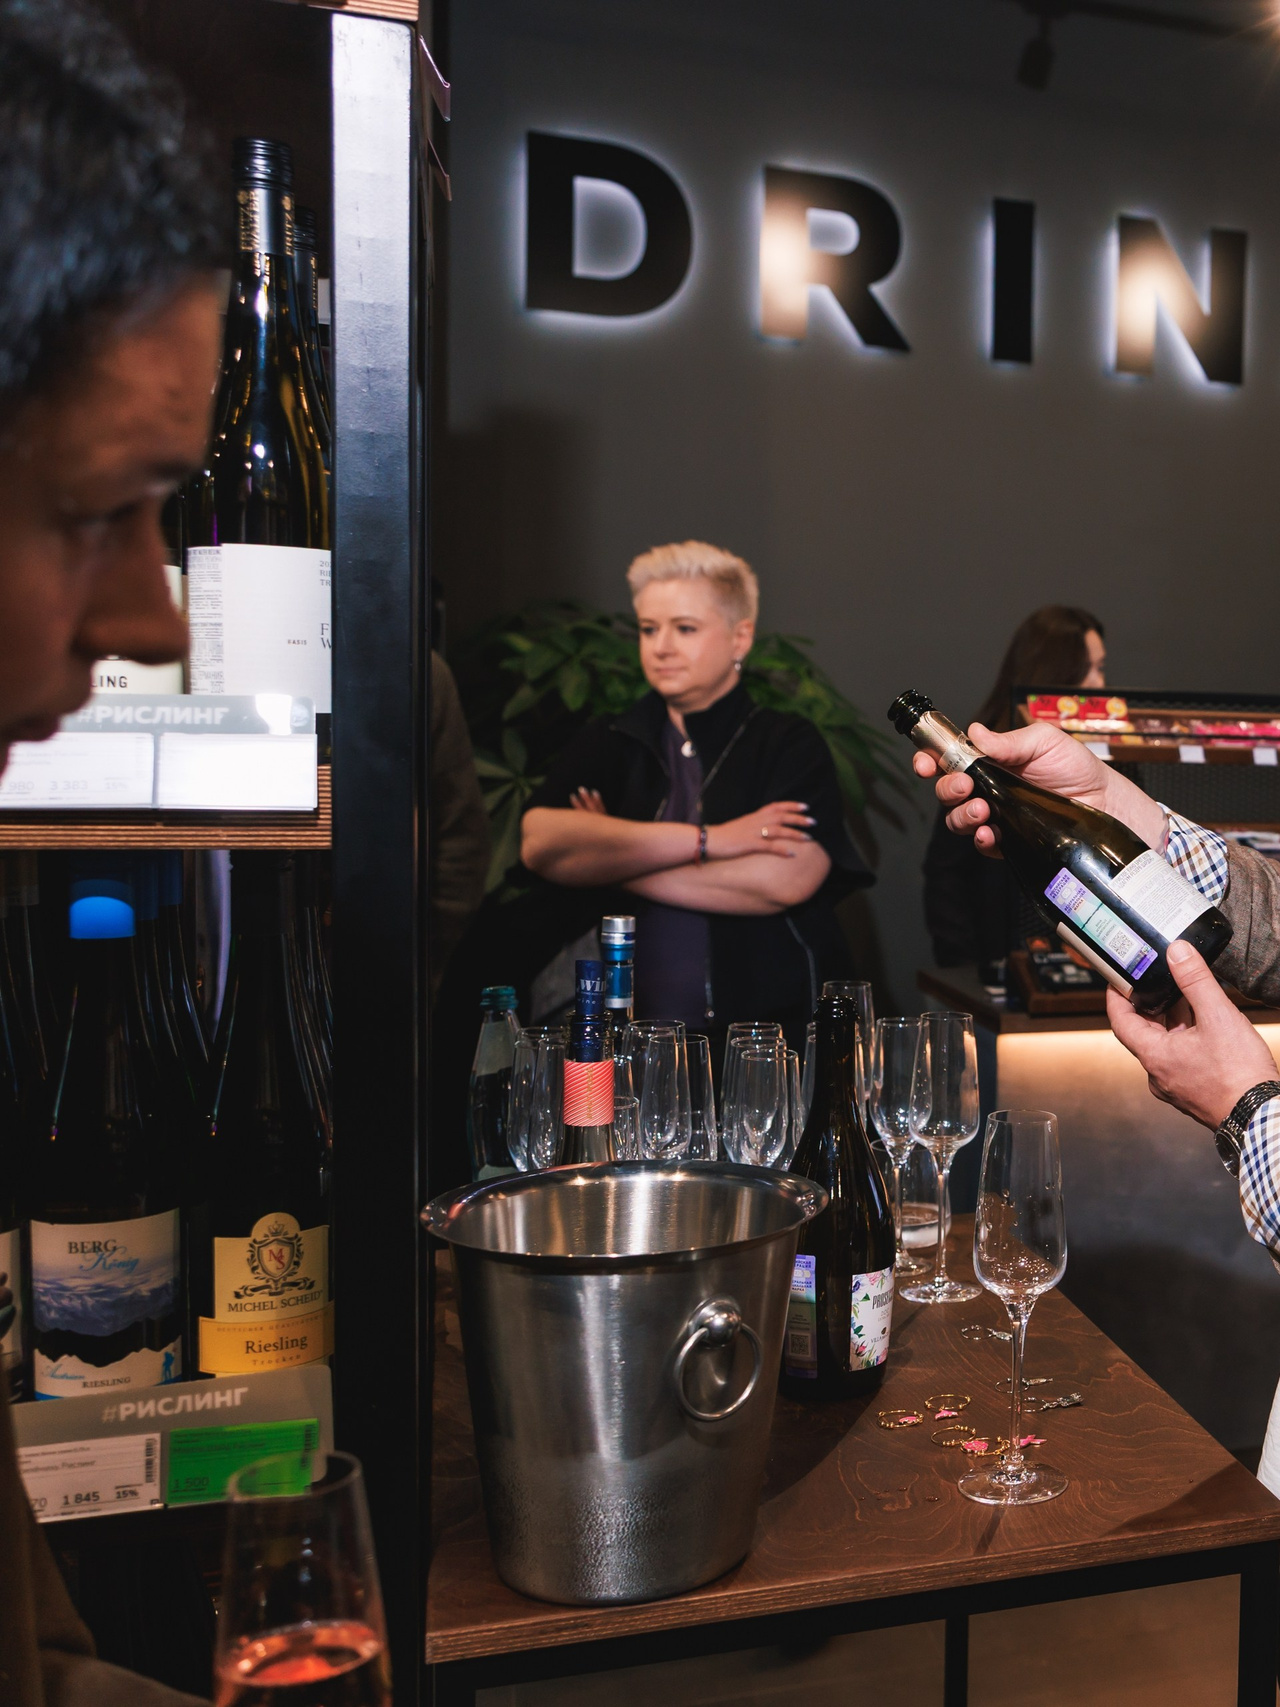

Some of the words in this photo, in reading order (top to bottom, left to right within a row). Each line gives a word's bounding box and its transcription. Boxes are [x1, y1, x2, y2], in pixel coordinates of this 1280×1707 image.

[240, 207, 253, 251] FRITZ
[284, 212, 294, 256] FRITZ
[67, 1239, 118, 1254] BERG
[79, 1246, 140, 1274] König
[227, 1300, 278, 1313] MICHEL
[280, 1290, 322, 1308] SCHEID
[244, 1336, 309, 1354] Riesling
[252, 1354, 302, 1365] Trocken
[82, 1376, 132, 1389] RIESLING
[101, 1387, 249, 1424] #РИСЛИНГ
[115, 1489, 139, 1499] 15%
